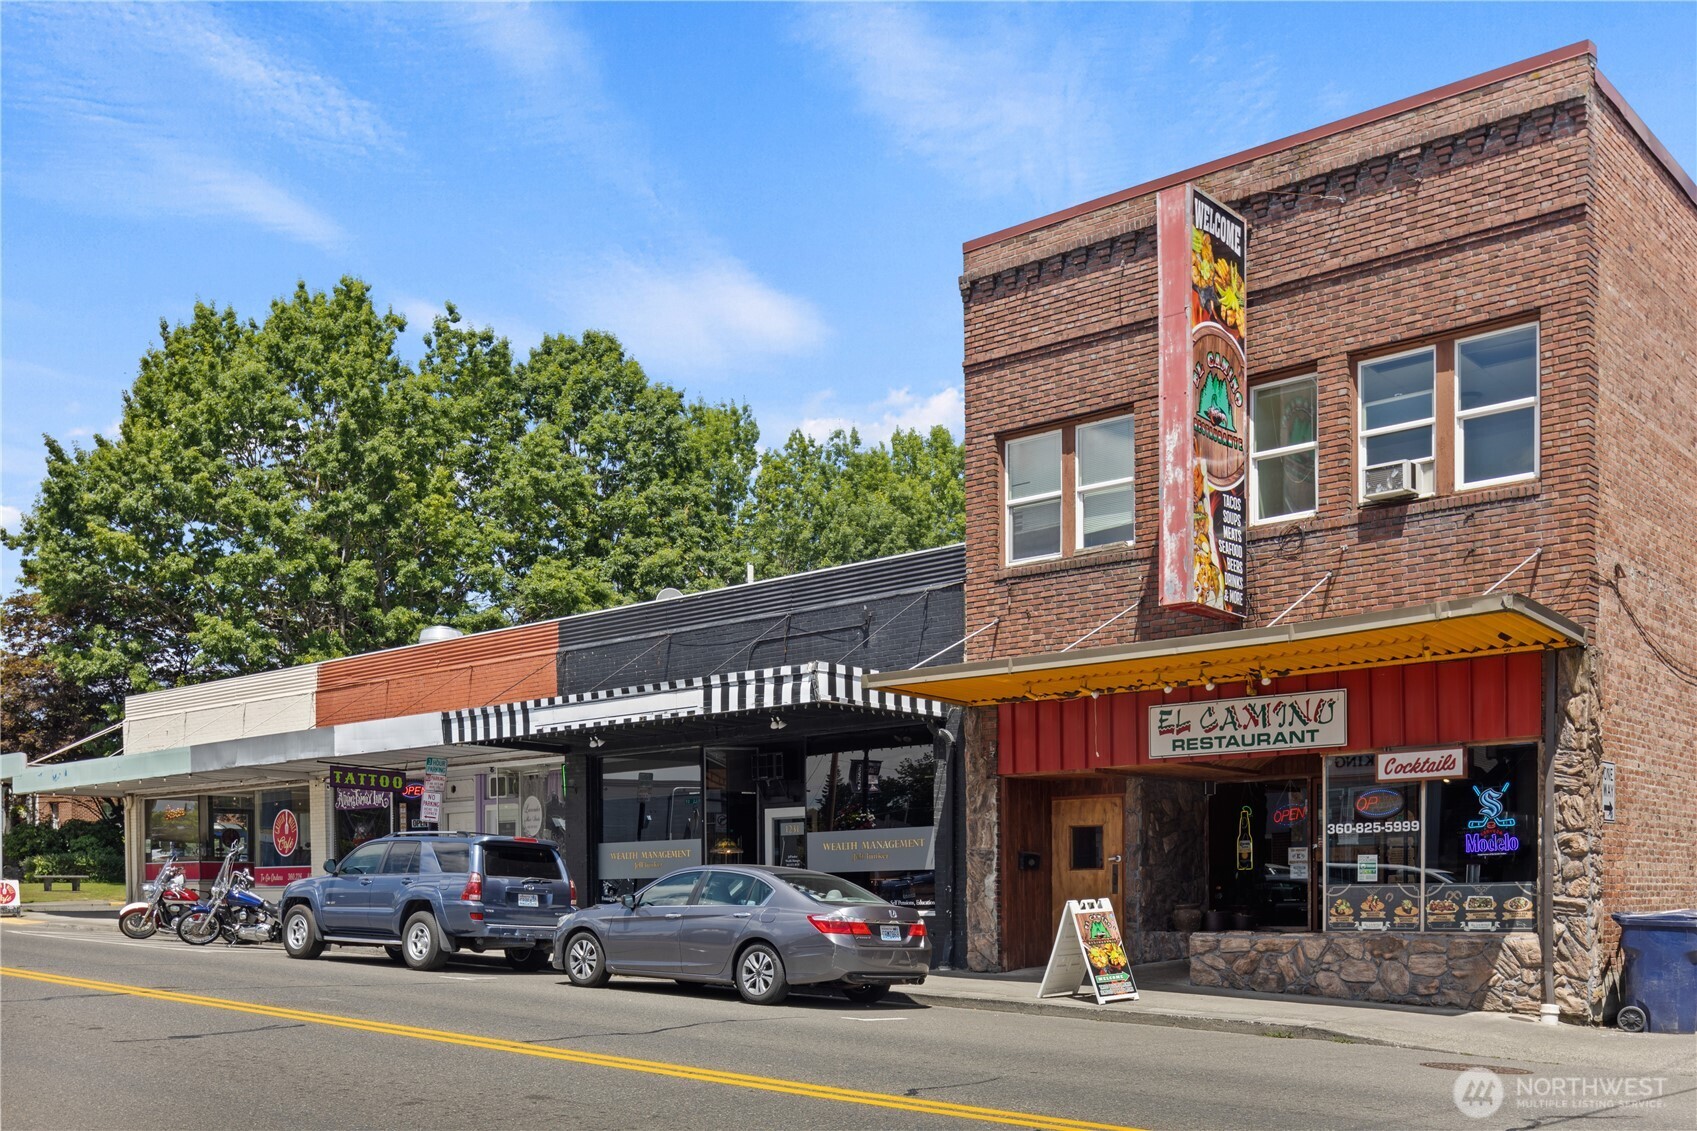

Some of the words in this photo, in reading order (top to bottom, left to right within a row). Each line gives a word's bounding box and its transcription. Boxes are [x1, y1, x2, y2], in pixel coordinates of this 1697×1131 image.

[1195, 198, 1241, 257] WELCOME
[1193, 361, 1205, 389] EL
[1207, 351, 1243, 407] CAMINO
[1222, 493, 1242, 511] TACOS
[1222, 509, 1242, 527] SOUPS
[1223, 525, 1242, 542] MEATS
[1219, 540, 1243, 558] SEAFOOD
[1227, 556, 1243, 574] BEERS
[1225, 572, 1244, 590] DRINKS
[1230, 590, 1243, 606] MORE
[1158, 709, 1191, 736] EL
[1200, 697, 1337, 734] CAMINO
[1172, 729, 1320, 752] RESTAURANT
[427, 766, 446, 774] PARKING
[1384, 753, 1457, 775] Cocktails
[333, 771, 403, 789] TATTOO
[423, 800, 440, 808] PARKING
[1273, 806, 1307, 823] OPEN
[1327, 820, 1420, 835] 360-825-5999
[822, 841, 858, 851] WEALTH
[862, 839, 926, 849] MANAGEMENT
[1465, 832, 1520, 853] Modelo
[610, 851, 638, 860] WEALTH
[641, 849, 692, 859] MANAGEMENT
[1098, 974, 1124, 982] WELCOME
